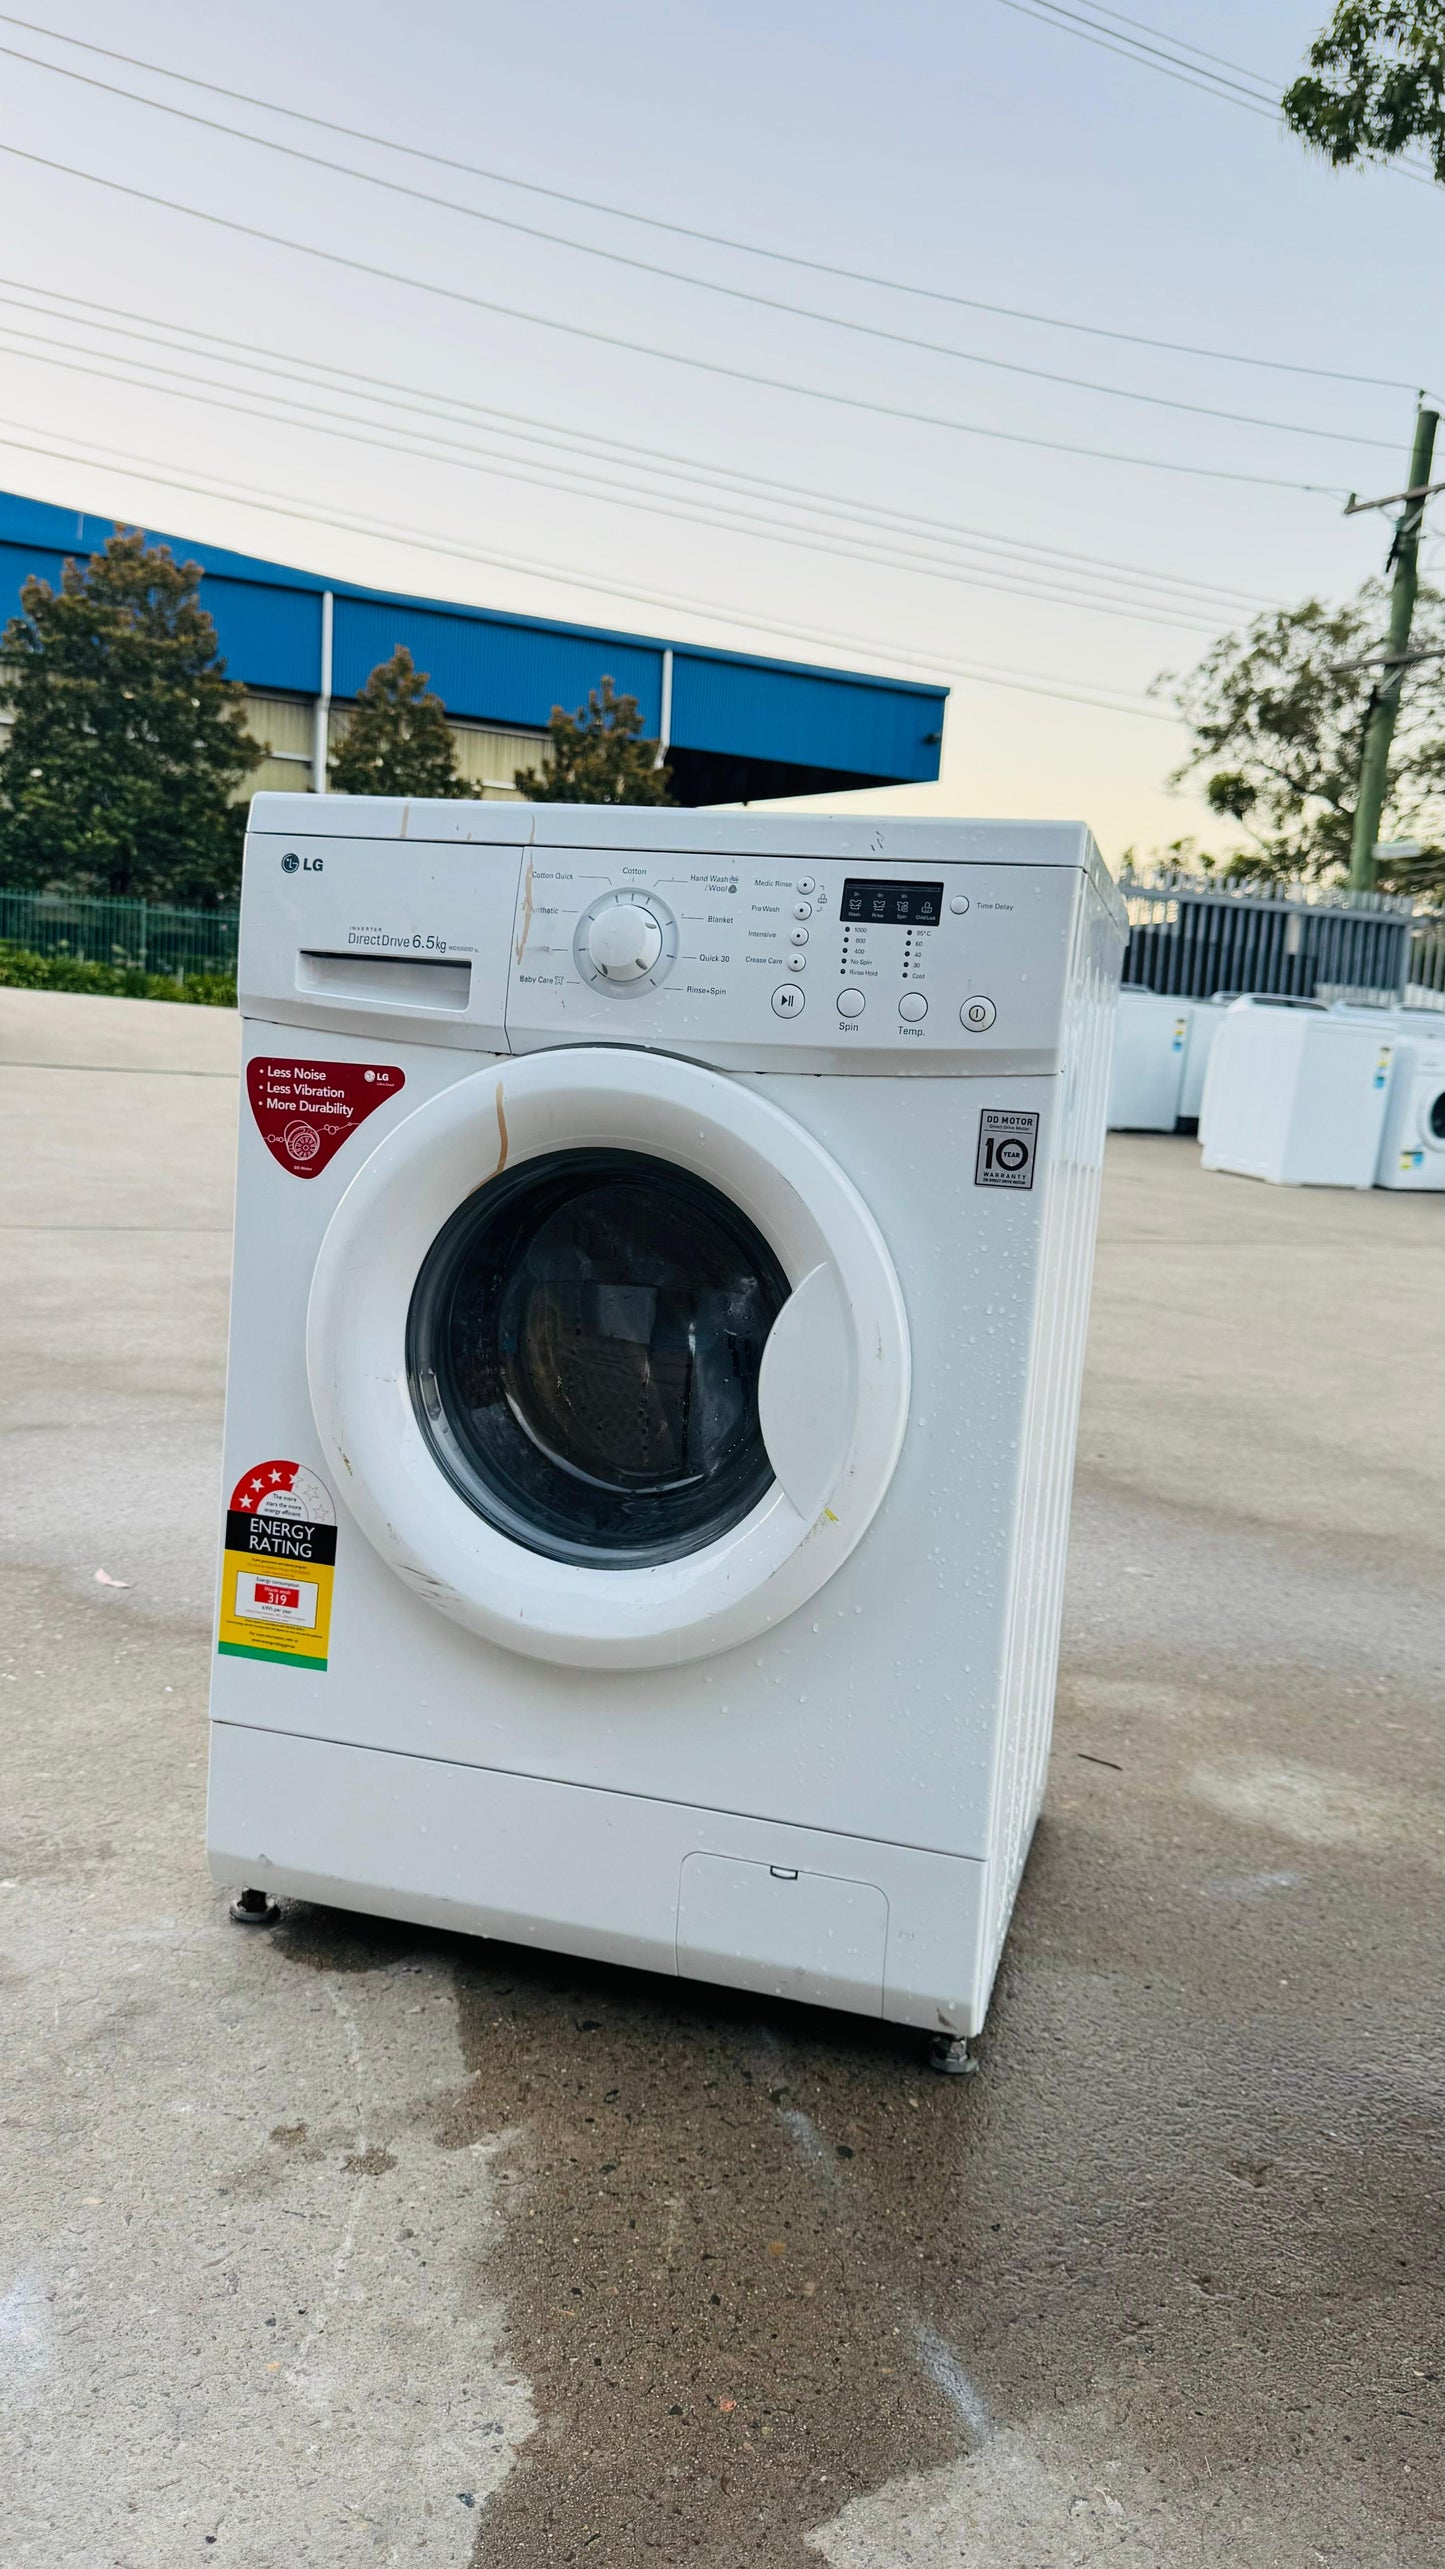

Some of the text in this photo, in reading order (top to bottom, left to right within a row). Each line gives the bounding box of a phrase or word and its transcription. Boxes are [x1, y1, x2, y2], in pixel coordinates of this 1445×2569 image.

[303, 858, 324, 872] LG
[531, 871, 573, 880] Cotton Quick
[622, 867, 647, 875] Cotton
[690, 874, 729, 883] Hand Wash
[754, 879, 792, 888] Medic Rinse
[762, 905, 780, 913] Wash
[977, 902, 1014, 911] Time Delay
[708, 915, 733, 923] Blanket
[748, 930, 777, 938] Intensive
[699, 954, 730, 963] Quick 30
[745, 956, 783, 965] Crease Care
[520, 975, 554, 984] Baby Care
[839, 1022, 859, 1033] Spin
[897, 1026, 926, 1037] Temp.
[267, 1065, 327, 1081] Less Noise
[376, 1072, 389, 1082] LG
[266, 1082, 345, 1098] Less Vibration
[266, 1098, 354, 1118] More Durability
[986, 1115, 1033, 1126] DD MOTOR
[985, 1137, 1029, 1172] 10
[983, 1171, 1027, 1180] WARRANTY
[249, 1517, 316, 1541] ENERGY
[248, 1535, 313, 1558] RATING
[256, 1576, 271, 1584] Energy
[268, 1592, 288, 1605] 319
